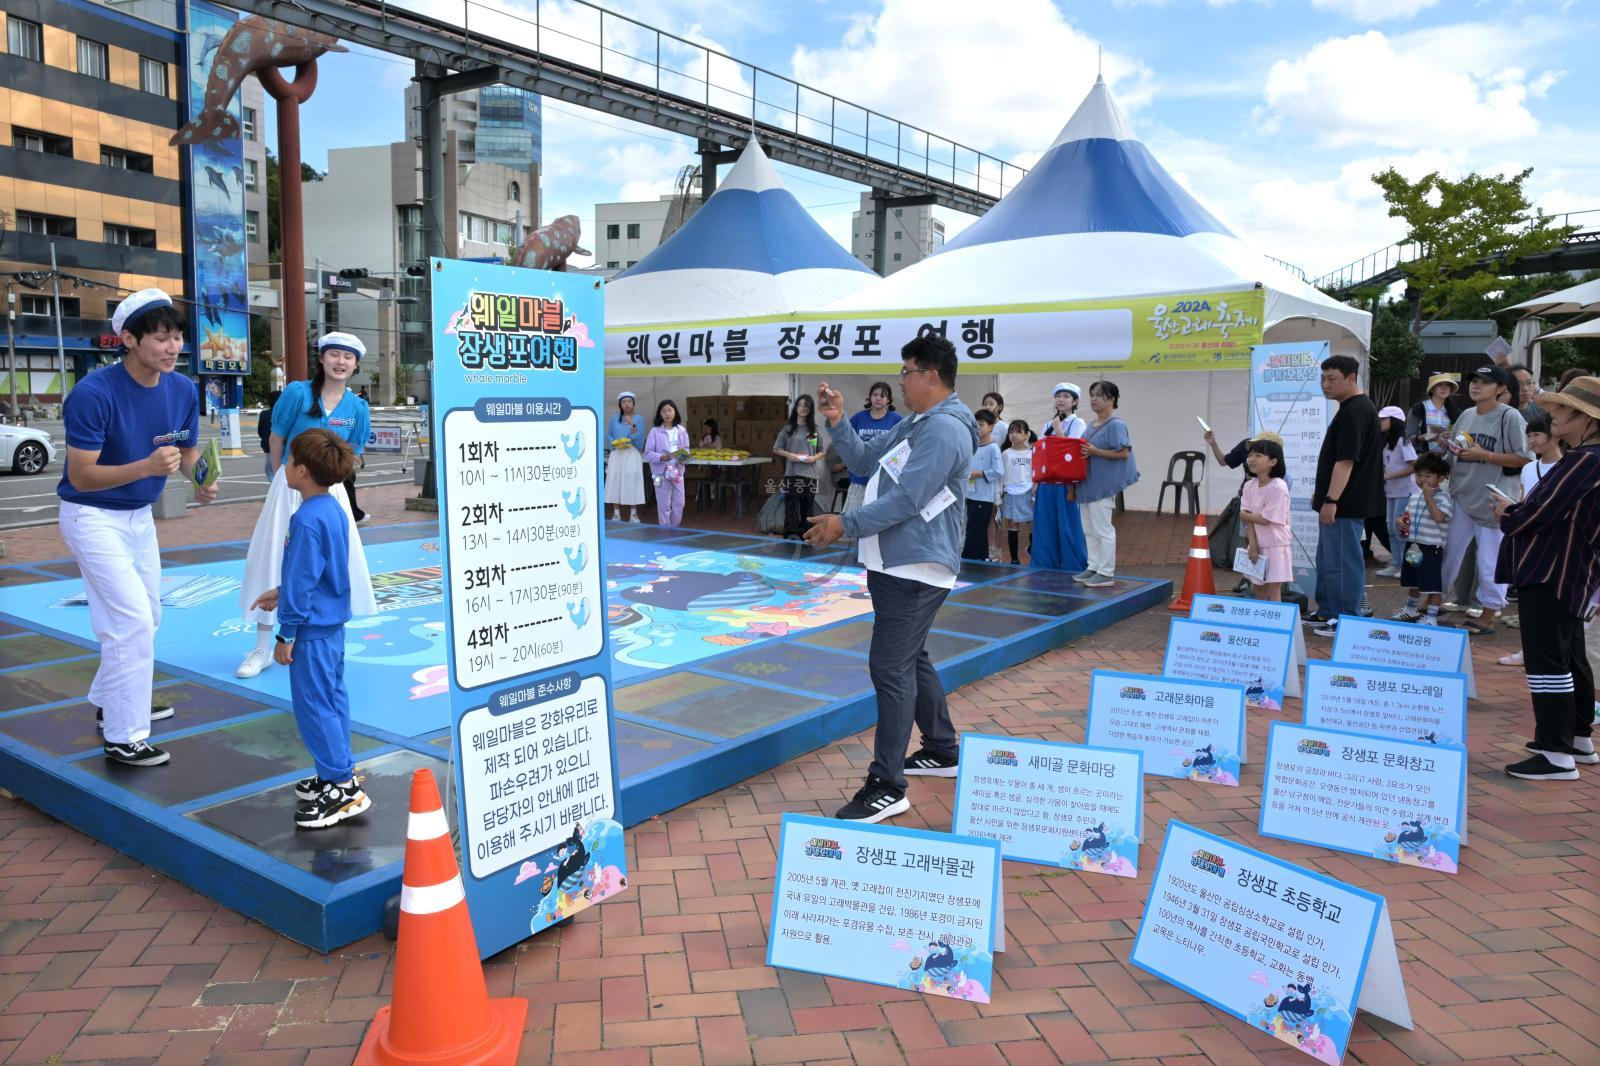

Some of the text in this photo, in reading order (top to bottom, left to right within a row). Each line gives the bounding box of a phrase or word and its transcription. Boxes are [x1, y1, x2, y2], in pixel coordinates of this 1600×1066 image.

[471, 293, 563, 334] 웨일마블
[458, 331, 578, 370] 장생포여행
[627, 329, 749, 364] 웨일마블
[778, 323, 882, 360] 장생포
[464, 373, 528, 384] whale marble
[485, 402, 562, 416] 웨일마블 이용시간
[458, 440, 500, 464] 1회차
[459, 468, 485, 486] 10시
[461, 502, 504, 527] 2회차
[462, 531, 488, 551] 13시
[464, 563, 507, 590] 3회차
[465, 594, 491, 614] 16시
[467, 621, 510, 650] 4회차
[468, 652, 494, 673] 19시
[499, 676, 572, 708] 웨일마블 준수사항
[472, 698, 599, 752] 웨일마블은 강화유리로
[483, 725, 592, 776] 제작 되어 있습니다.
[1341, 746, 1379, 764] 장생포
[1382, 752, 1435, 773] 문화창고
[489, 749, 590, 801] 파손우려가 있으니
[1028, 755, 1064, 773] 새미골
[1067, 759, 1116, 778] 문화마당
[483, 771, 600, 831] 담당자의 안내에 따라
[477, 793, 609, 860] 이용해 주시기 바랍니다.
[856, 846, 975, 879] 장생포 고래박물관
[1237, 868, 1342, 924] 장생포 초등학교
